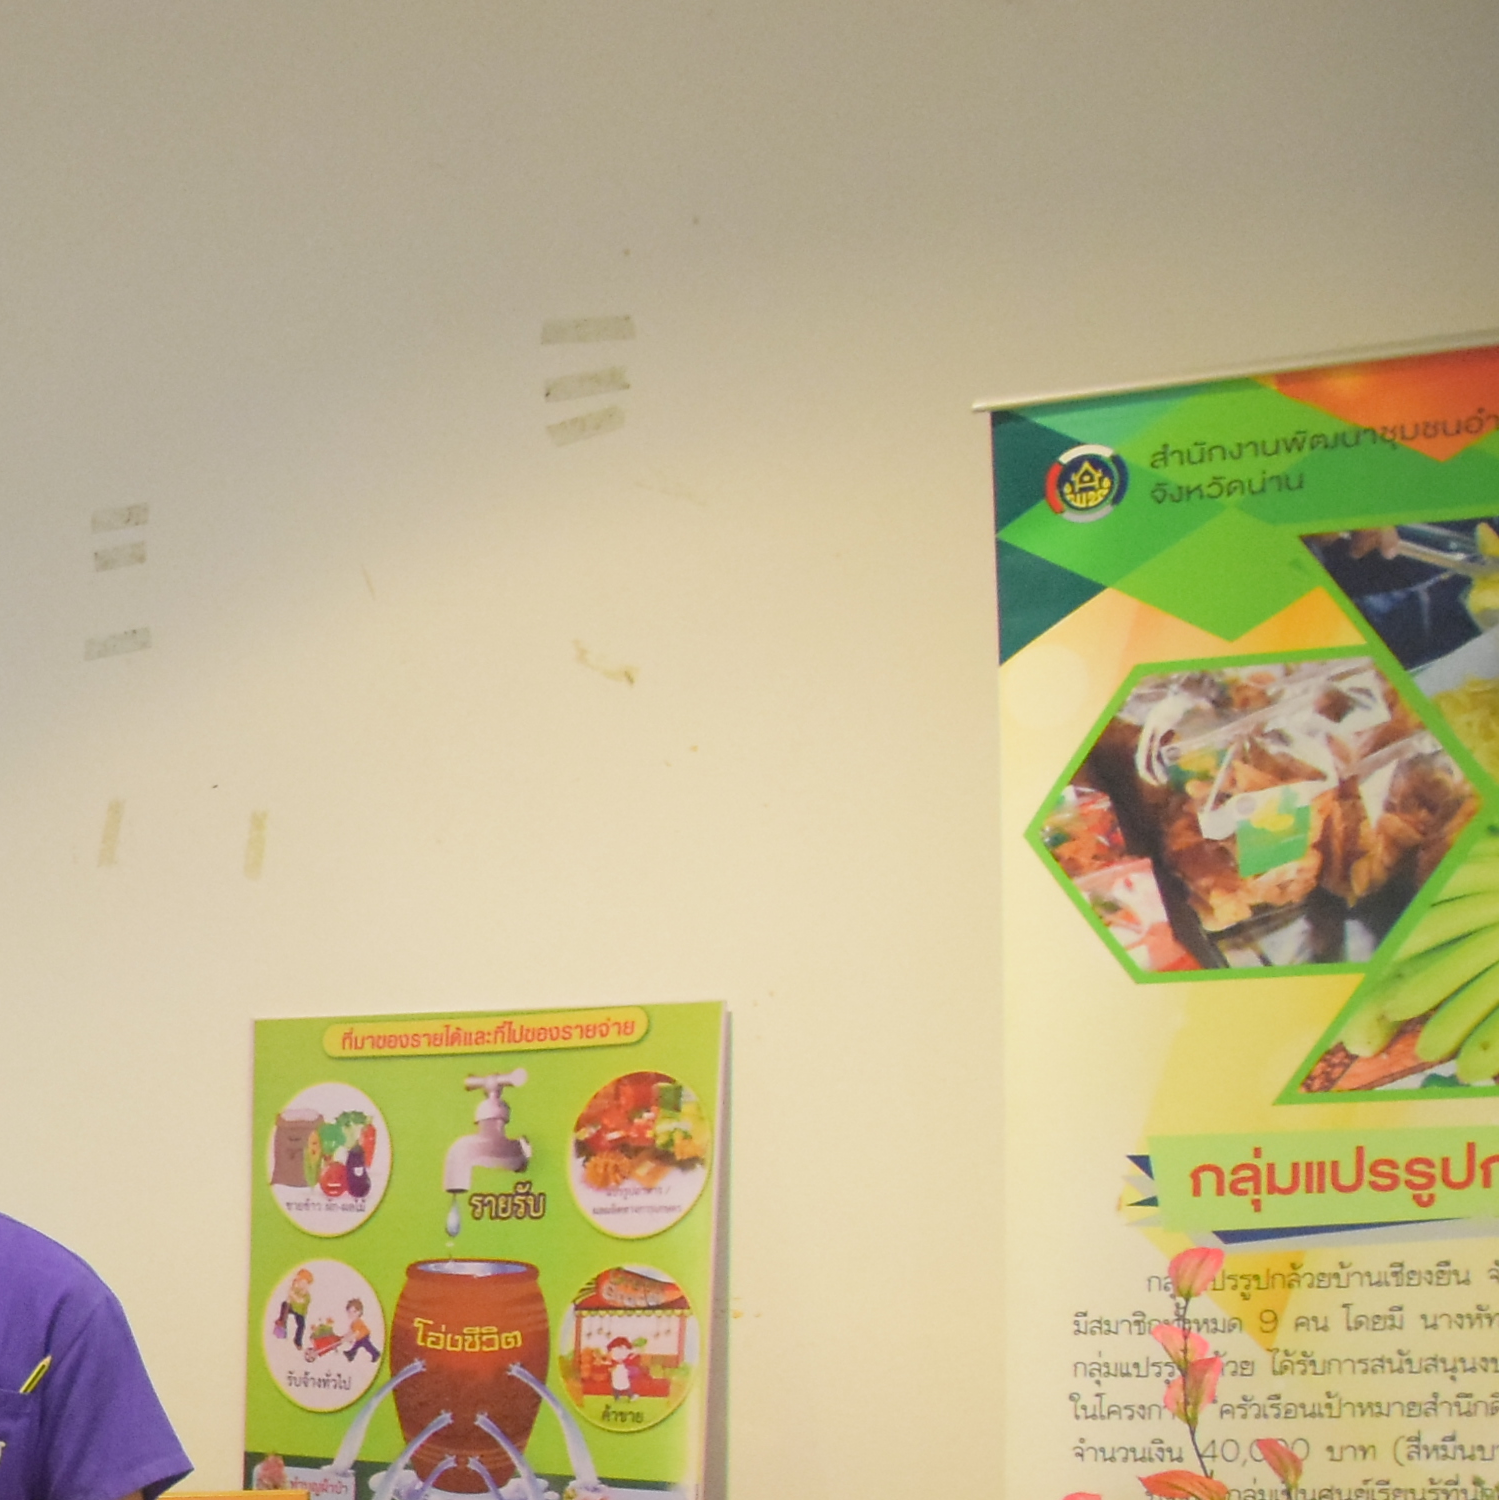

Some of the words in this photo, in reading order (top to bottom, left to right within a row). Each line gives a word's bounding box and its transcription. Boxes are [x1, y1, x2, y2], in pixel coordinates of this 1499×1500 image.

[1149, 471, 1305, 505] จังหวัดน่าน
[340, 1017, 635, 1051] ที่มาของรายได้และที่ไปของรายจ่าย
[467, 1182, 547, 1221] รายรับ
[1258, 1308, 1280, 1334] 9
[1294, 1313, 1330, 1333] คน
[1342, 1302, 1405, 1332] โดยมี
[414, 1317, 523, 1354] โอ่งชีวิต
[285, 1368, 352, 1392] รับจ้างทั่วไป
[602, 1406, 644, 1424] ค้าขาย
[1072, 1437, 1184, 1463] จำนวนเงิน
[1201, 1437, 1310, 1468] 40,00
[1326, 1443, 1377, 1462] บาท
